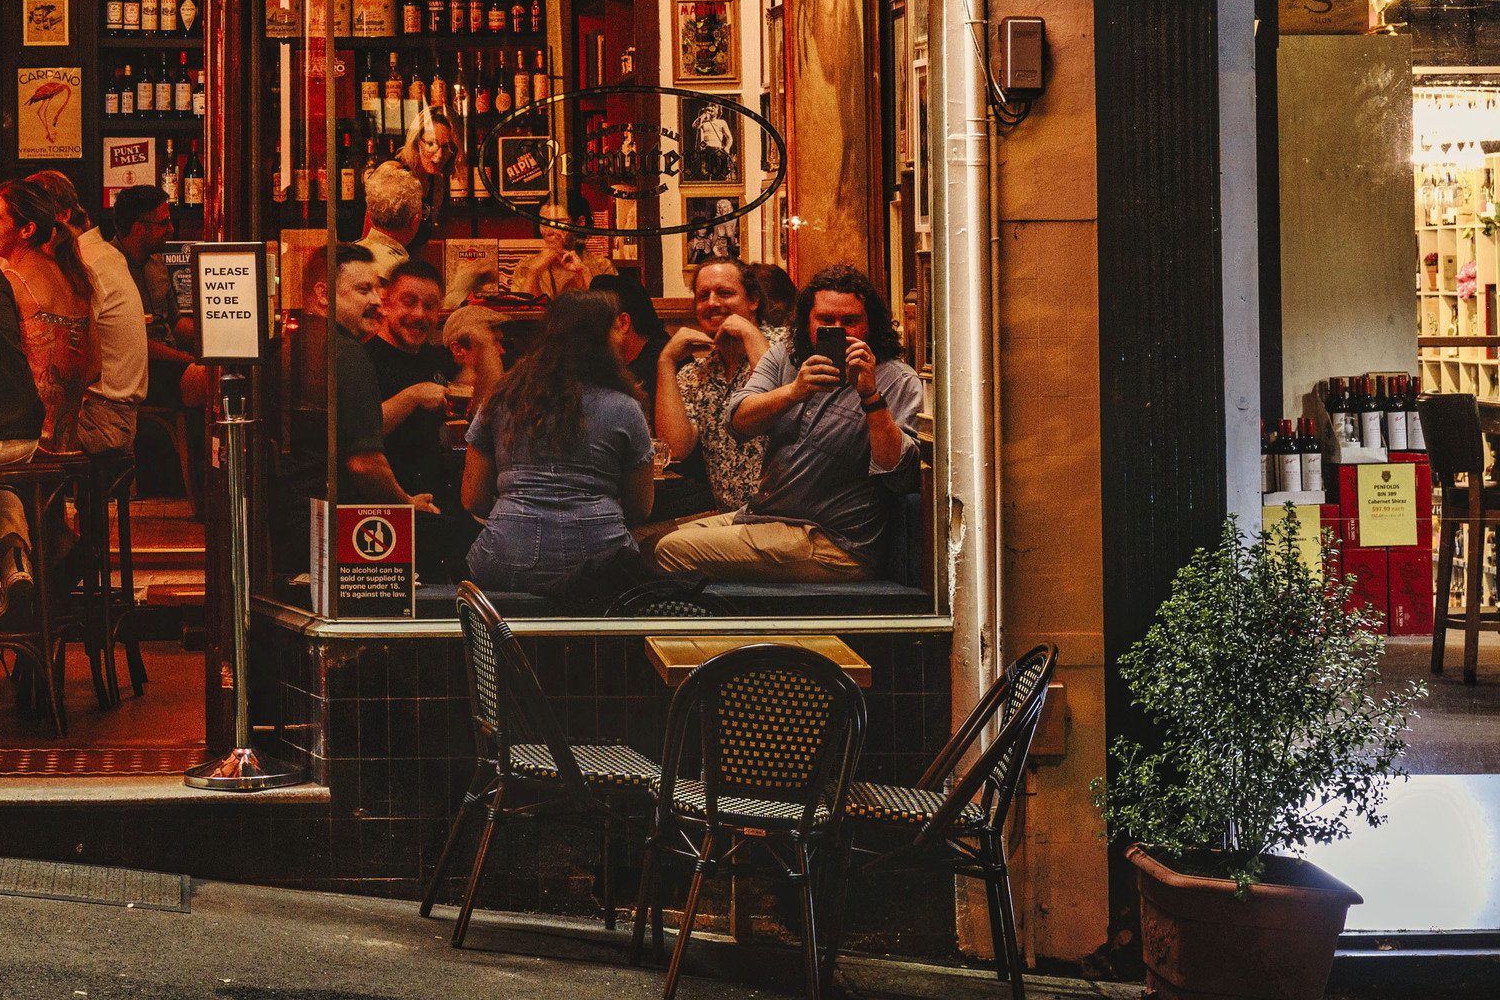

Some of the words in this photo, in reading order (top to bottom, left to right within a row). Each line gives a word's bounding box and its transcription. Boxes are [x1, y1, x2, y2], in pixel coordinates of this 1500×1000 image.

[680, 3, 727, 16] MARTINI
[304, 64, 345, 72] ZARO
[19, 69, 81, 87] CARPANO
[48, 145, 81, 154] TORINO
[113, 145, 140, 156] PUNT
[120, 153, 147, 165] MES
[166, 255, 190, 263] NOILLY
[459, 251, 486, 259] MARTINI
[205, 268, 249, 276] PLEASE
[205, 282, 235, 290] WAIT
[206, 311, 251, 319] SEATED
[366, 575, 396, 583] supplied
[352, 591, 378, 599] against
